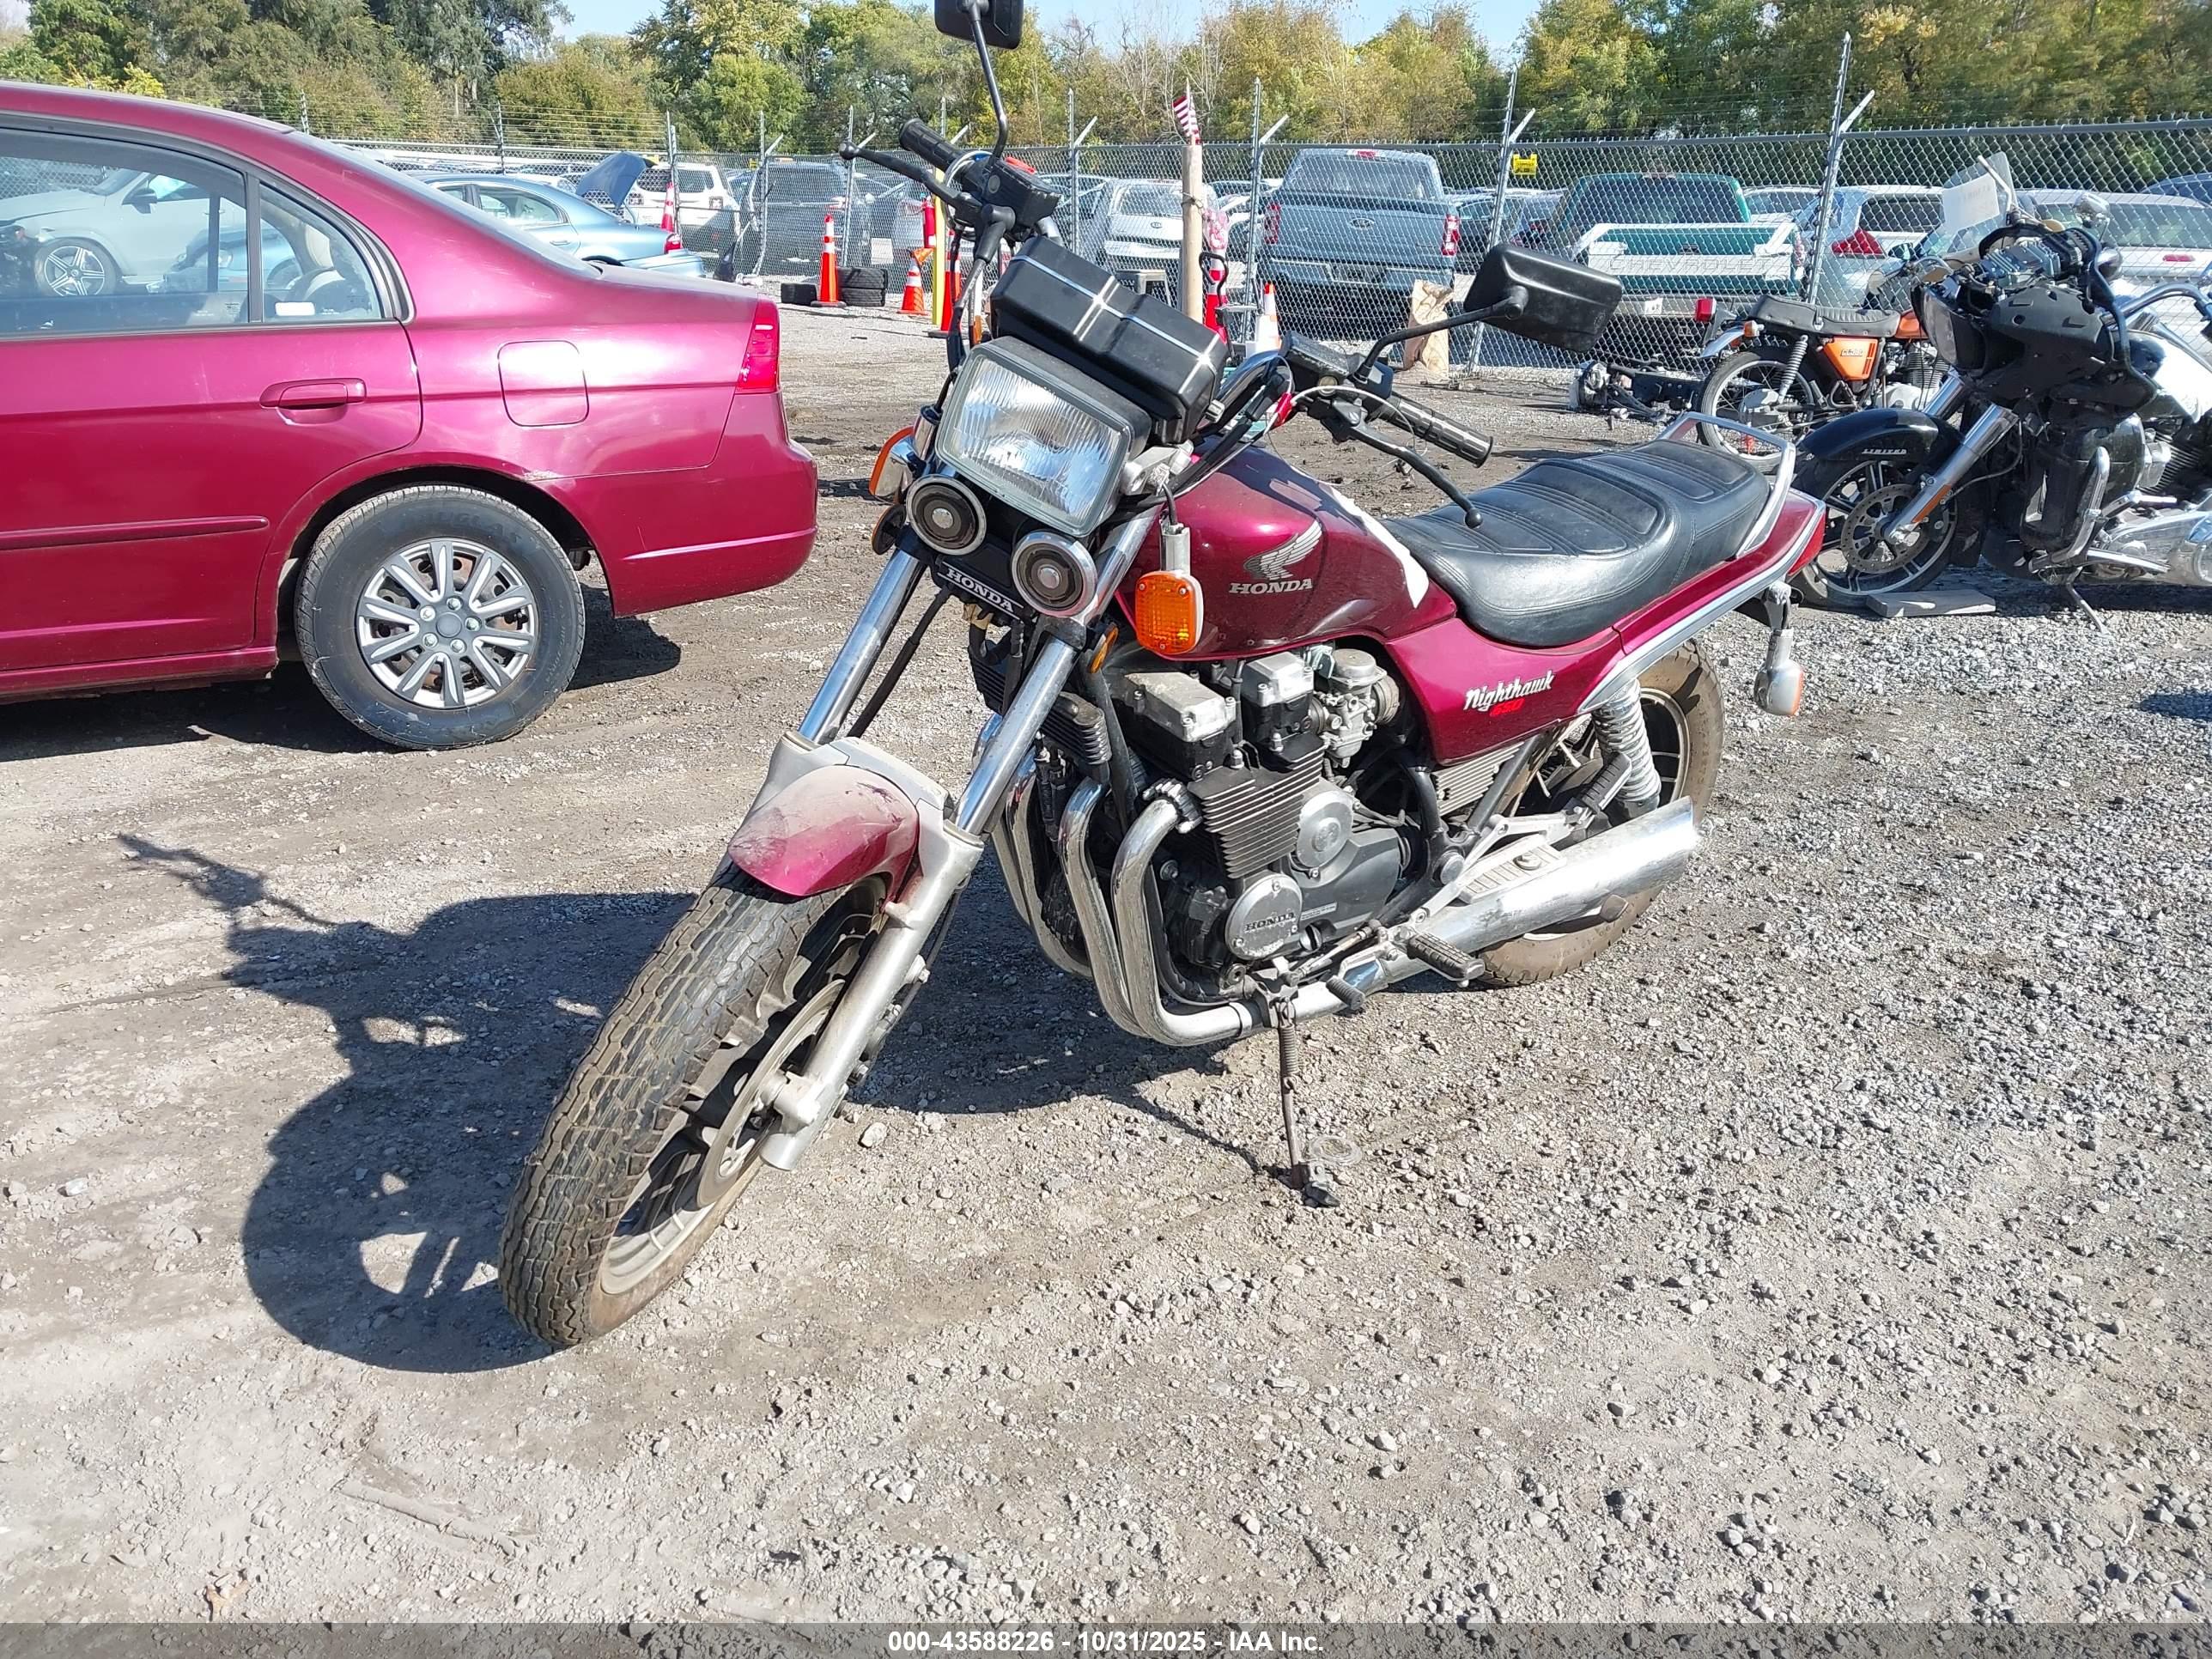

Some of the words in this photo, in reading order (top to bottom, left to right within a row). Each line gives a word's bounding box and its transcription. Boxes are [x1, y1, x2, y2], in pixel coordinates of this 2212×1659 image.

[1609, 258, 1771, 270] CHEVROLET
[946, 568, 1014, 612] HONDA
[1229, 578, 1313, 594] HONDA
[1463, 670, 1554, 712] Nighthawk
[1244, 912, 1295, 932] HONDA
